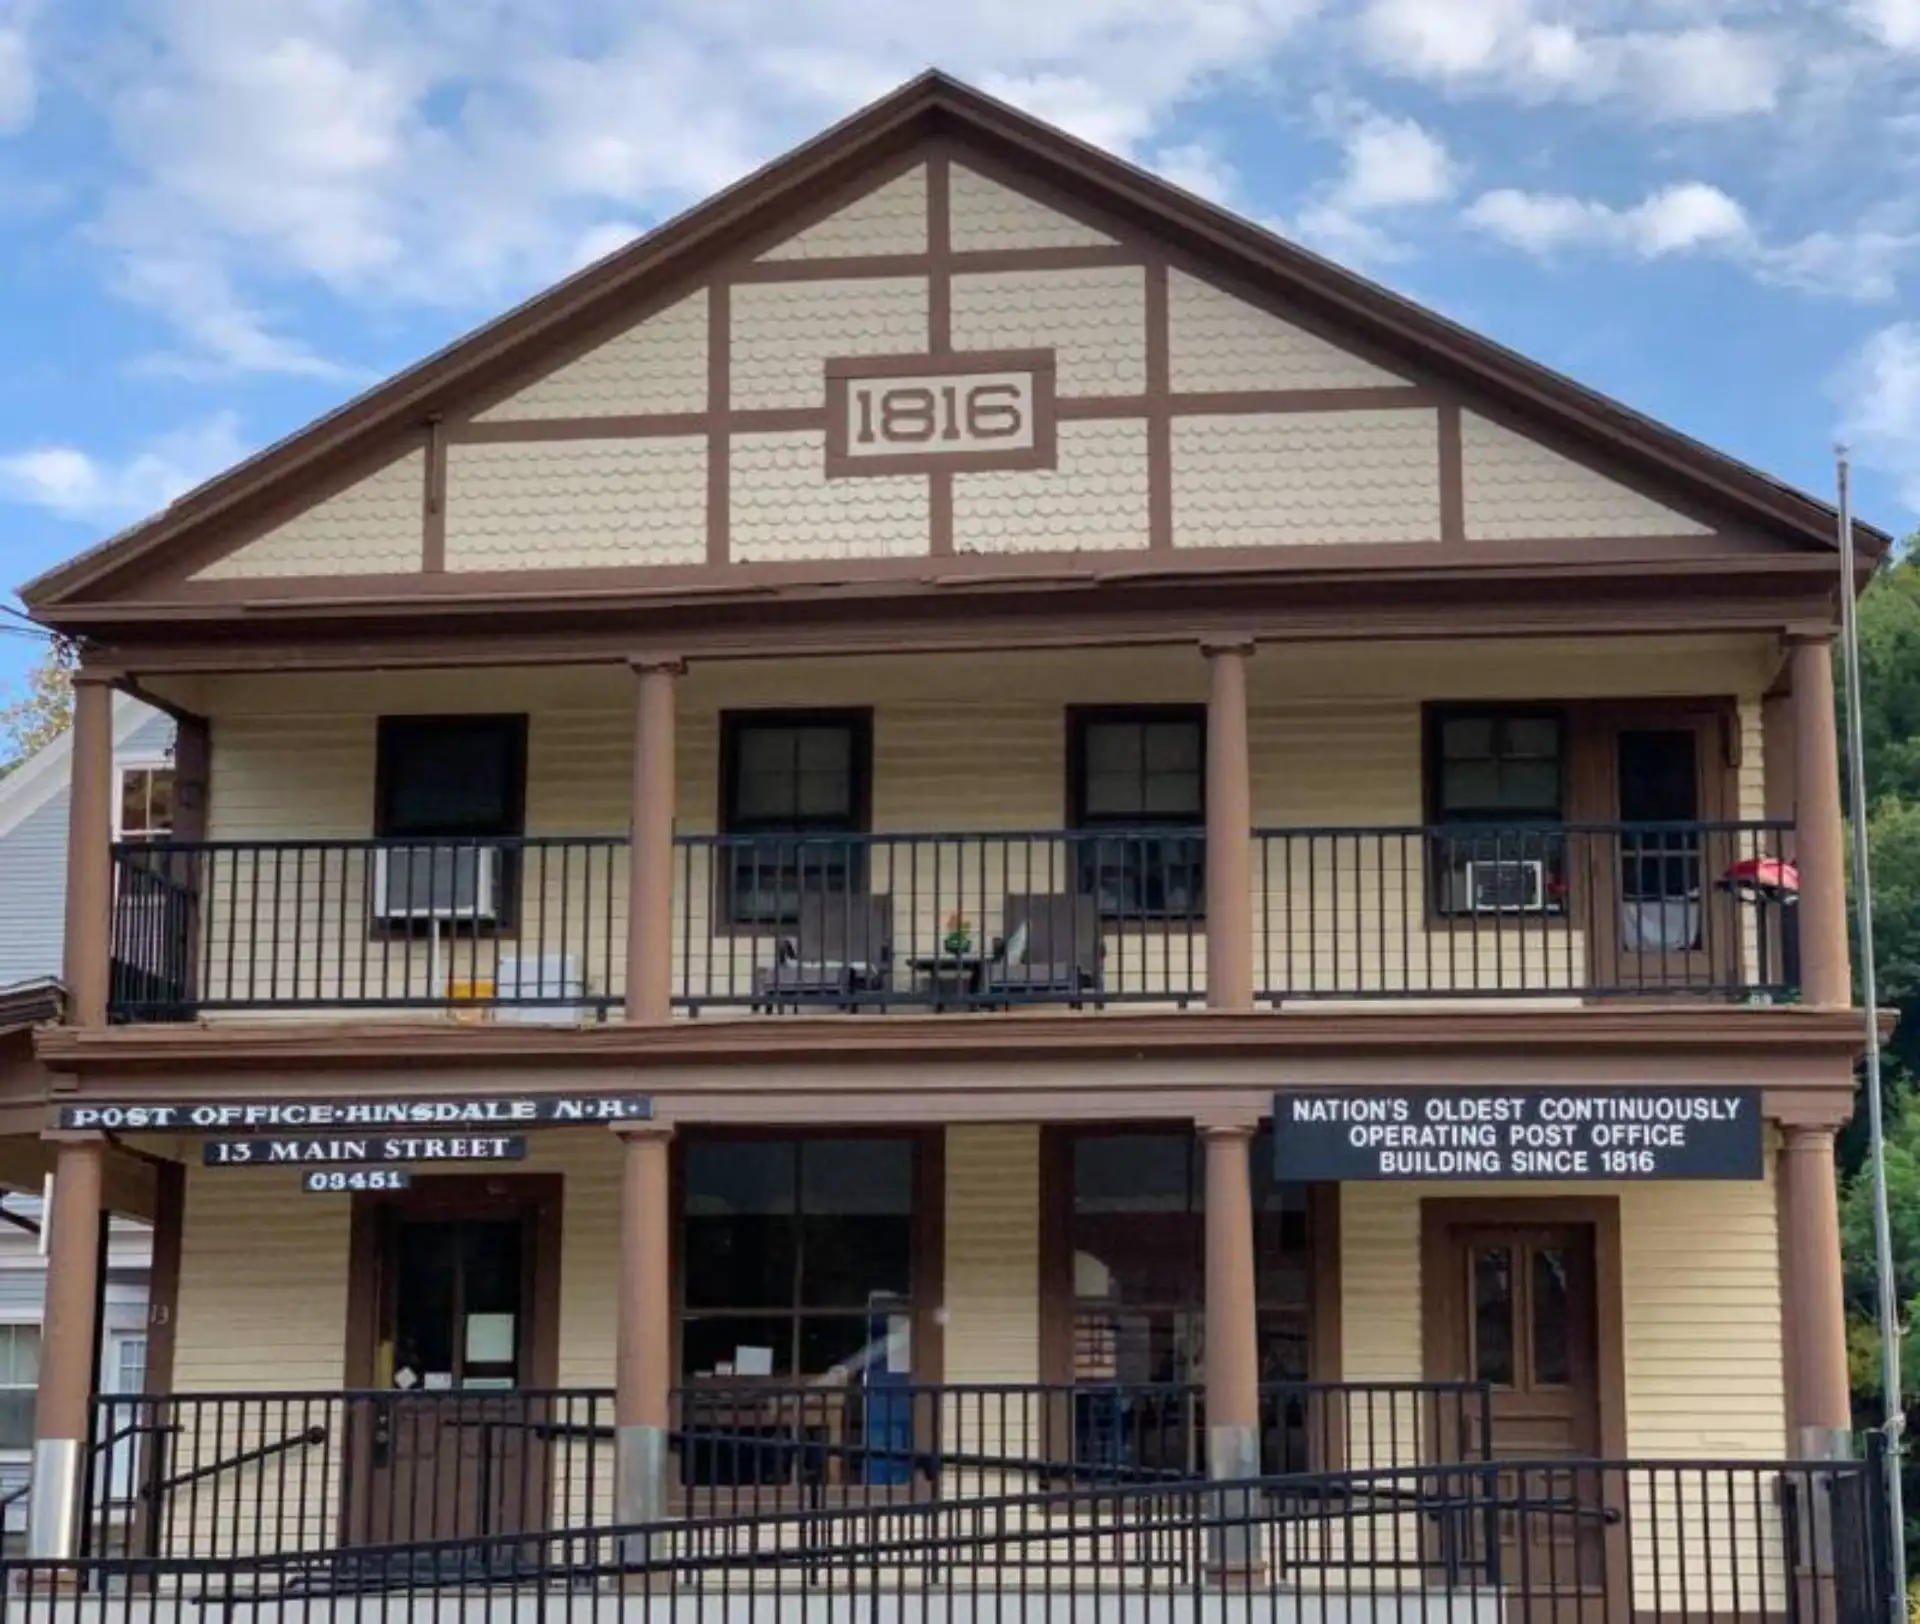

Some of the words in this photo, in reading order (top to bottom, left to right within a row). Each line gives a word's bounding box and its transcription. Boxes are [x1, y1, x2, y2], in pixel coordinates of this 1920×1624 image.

[857, 384, 1021, 442] 1816
[73, 1107, 176, 1126] POST
[1293, 1099, 1408, 1121] NATION'S
[1425, 1099, 1525, 1121] OLDEST
[1540, 1098, 1741, 1121] CONTINUOUSLY
[1349, 1125, 1496, 1147] OPERATING
[1510, 1124, 1577, 1146] POST
[1591, 1124, 1685, 1146] OFFICE
[268, 1140, 366, 1160] MAIN
[384, 1138, 510, 1159] STREET
[1380, 1151, 1500, 1172] BUILDING
[1511, 1151, 1588, 1172] SINCE
[1601, 1150, 1655, 1172] 1816
[308, 1171, 402, 1191] 03451
